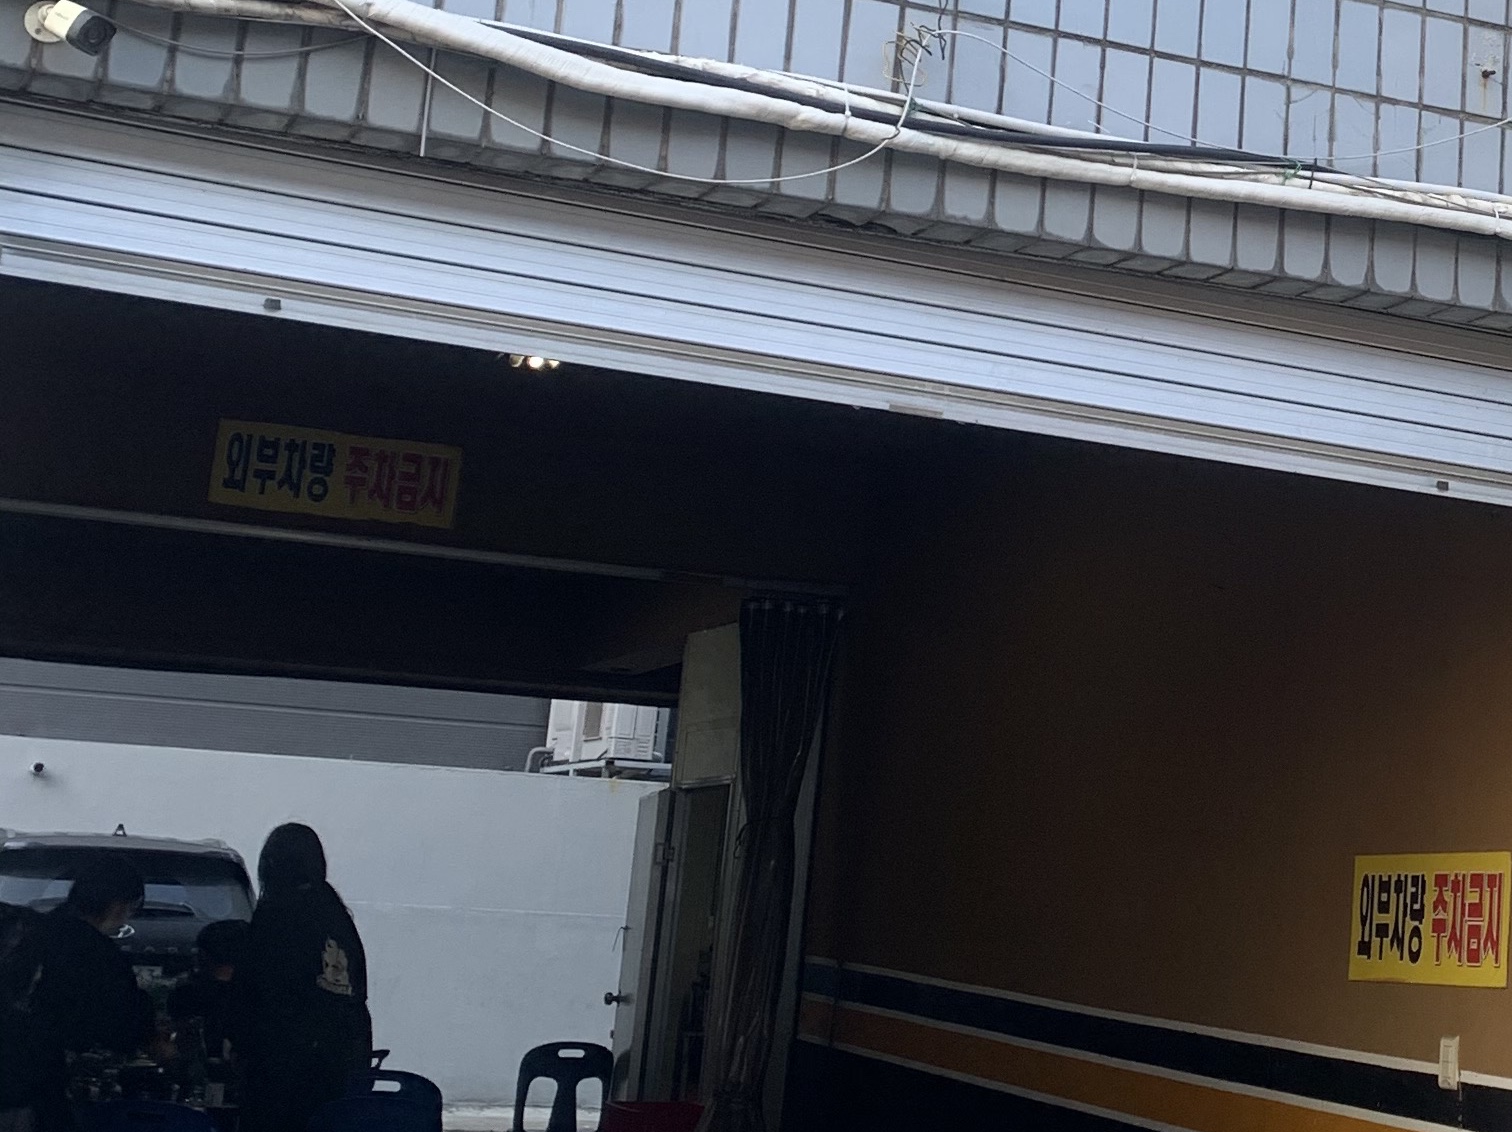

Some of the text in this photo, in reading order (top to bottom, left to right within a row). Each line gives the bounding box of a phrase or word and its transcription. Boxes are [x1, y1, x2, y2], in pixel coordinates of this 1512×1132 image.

[222, 431, 449, 514] 외부차량 주차금지
[1356, 871, 1504, 969] 외부차량 주차금지
